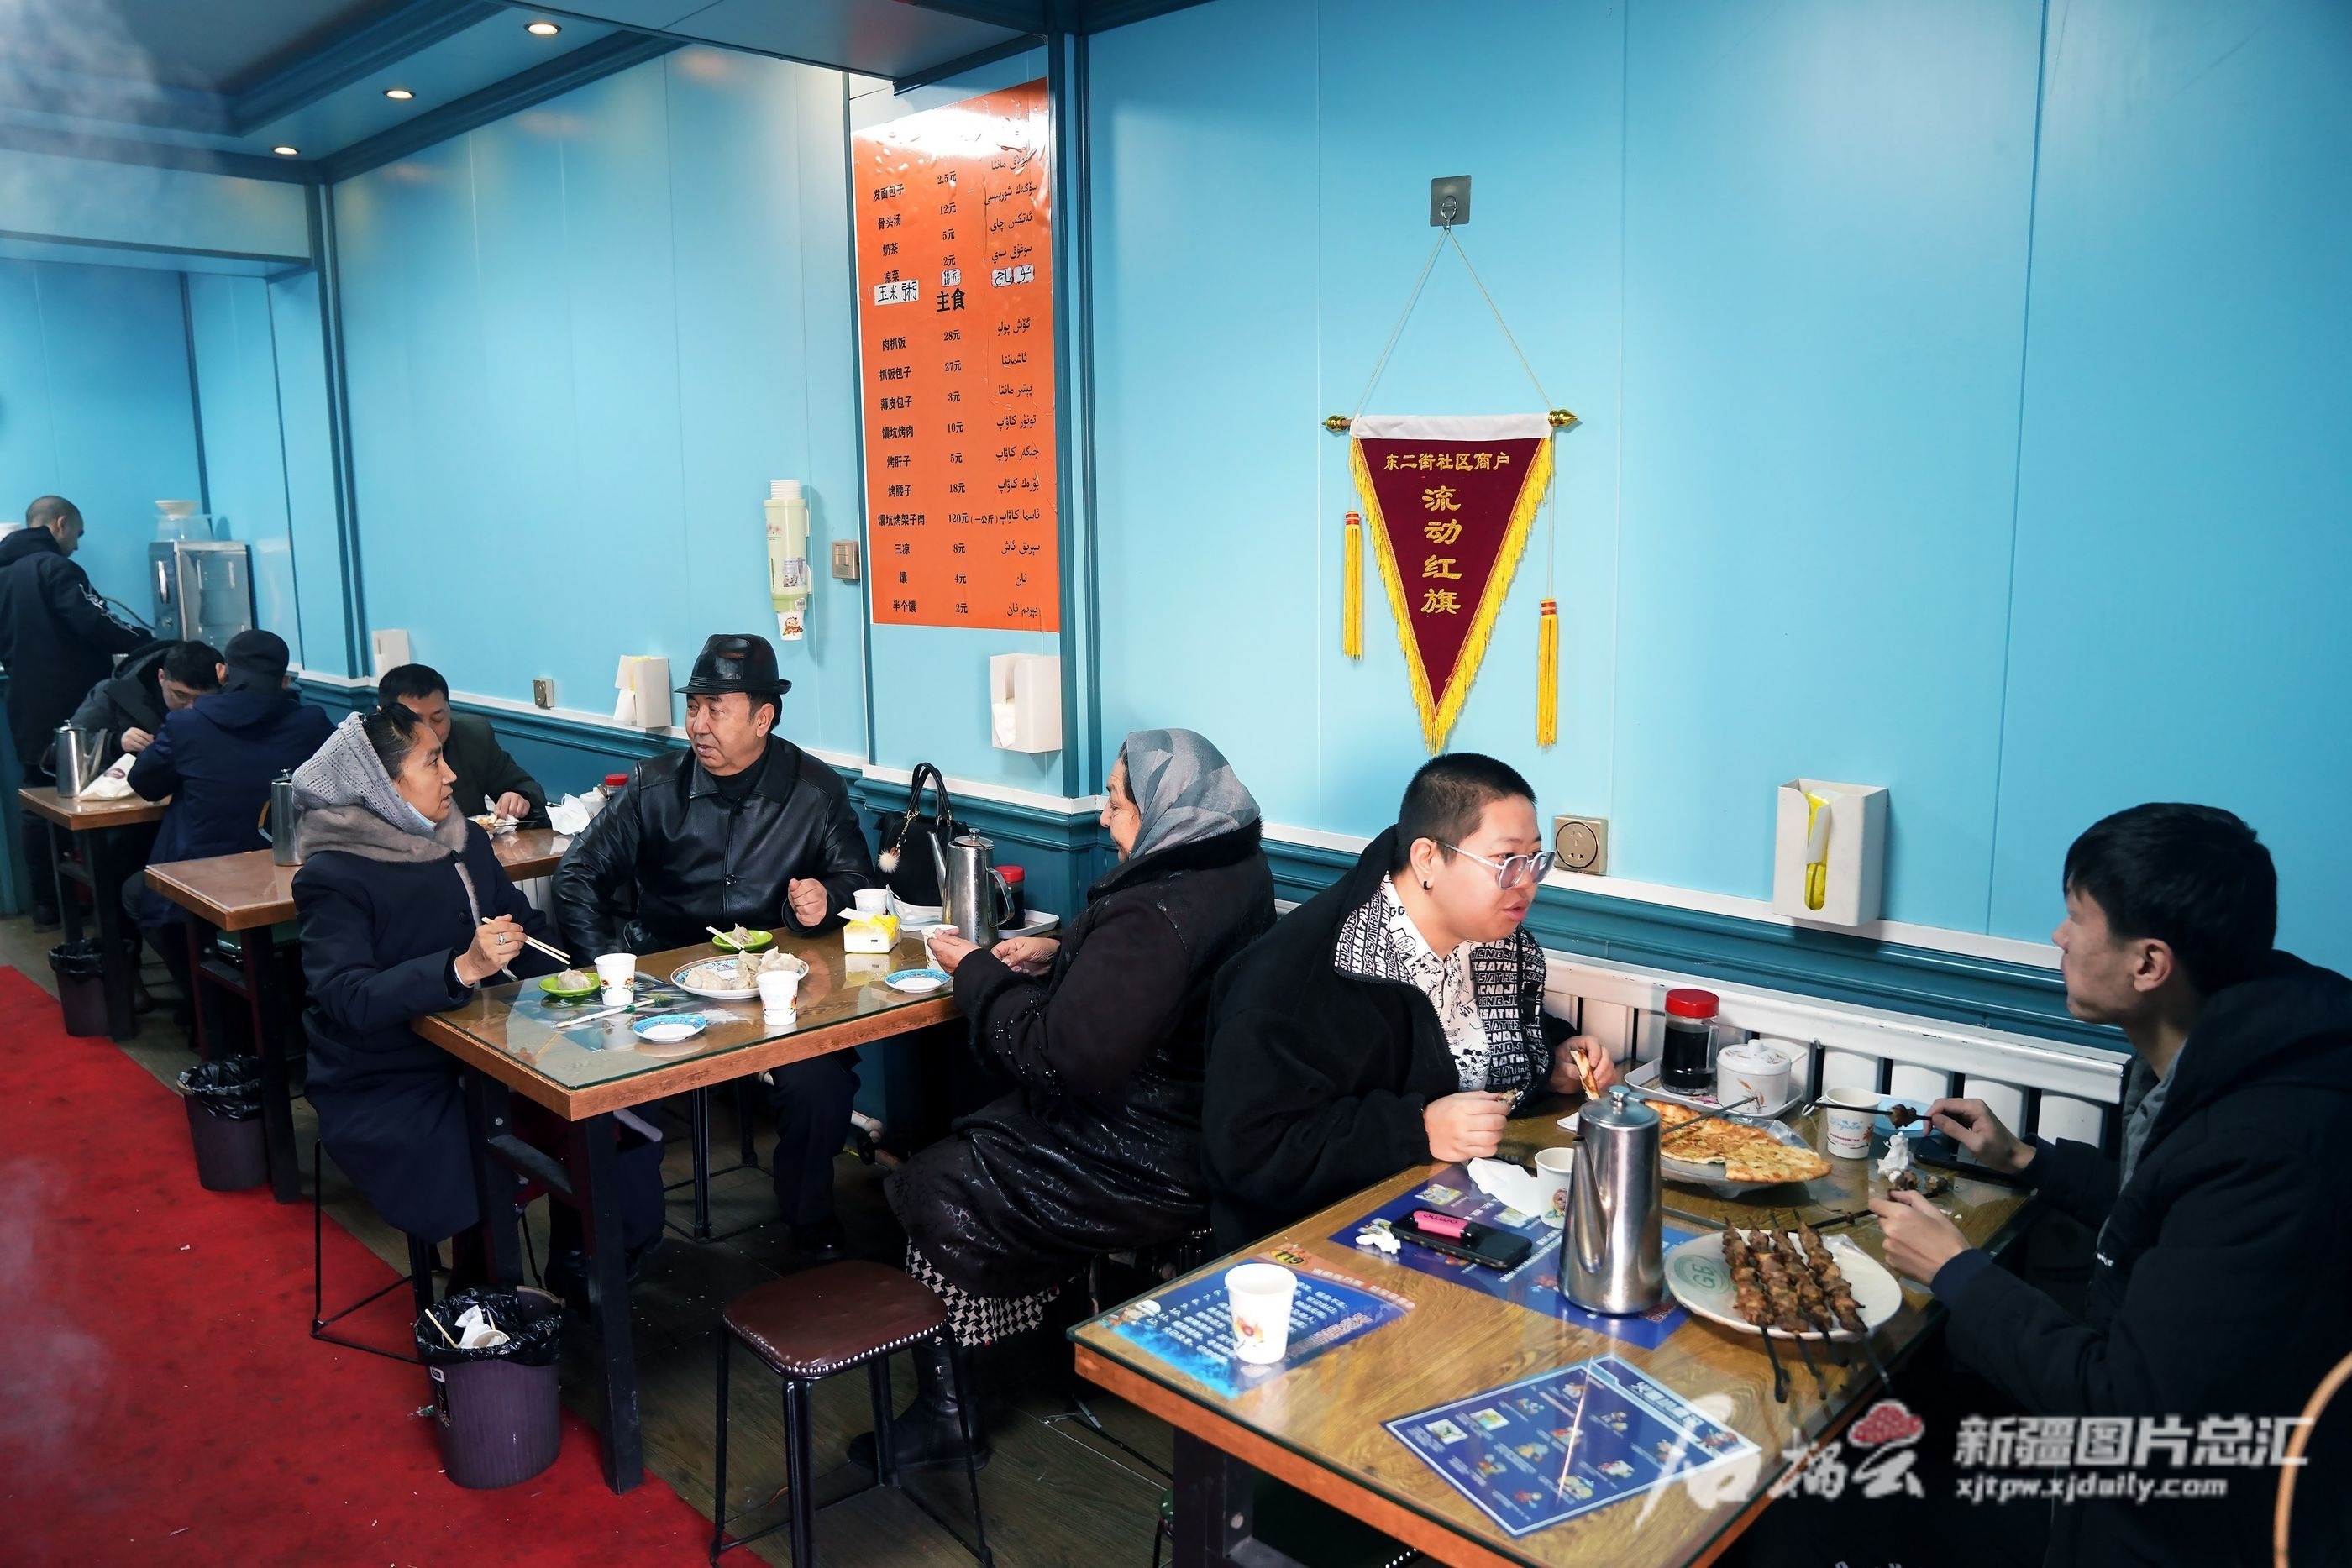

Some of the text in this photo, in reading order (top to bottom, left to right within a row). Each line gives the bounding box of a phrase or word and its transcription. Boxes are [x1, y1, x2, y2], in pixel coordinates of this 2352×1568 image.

[937, 171, 957, 185] 2.5元
[873, 184, 905, 202] 发面包子
[940, 202, 956, 215] 12元
[877, 213, 901, 230] 骨头汤
[942, 228, 955, 241] 5元
[882, 242, 899, 256] 奶茶
[943, 254, 956, 266] 2元
[883, 269, 900, 283] 凉菜
[878, 281, 918, 302] 玉米粥
[937, 288, 966, 312] 主食
[943, 329, 961, 341] 28元
[882, 337, 906, 352] 肉抓饭
[945, 359, 962, 372] 27元
[879, 366, 911, 381] 抓饭包子
[880, 396, 912, 411] 薄皮包子
[948, 391, 961, 403] 3元
[882, 426, 914, 439] 馕坑烤肉
[947, 422, 963, 433] 10元
[887, 455, 911, 469] 烤肝子
[950, 452, 963, 464] 5元
[1383, 451, 1510, 471] 东二街社区商户
[888, 485, 911, 497] 烤腰子
[949, 482, 965, 493] 18元
[878, 514, 925, 527] 馕坑烤架子肉
[948, 512, 969, 524] 120元
[895, 543, 910, 555] 三凉
[953, 543, 965, 554] 8元
[1420, 485, 1463, 615] 流动红旗
[899, 571, 908, 584] 馕
[954, 574, 967, 584] 4元
[892, 600, 916, 613] 半个馕
[955, 603, 968, 614] 2元
